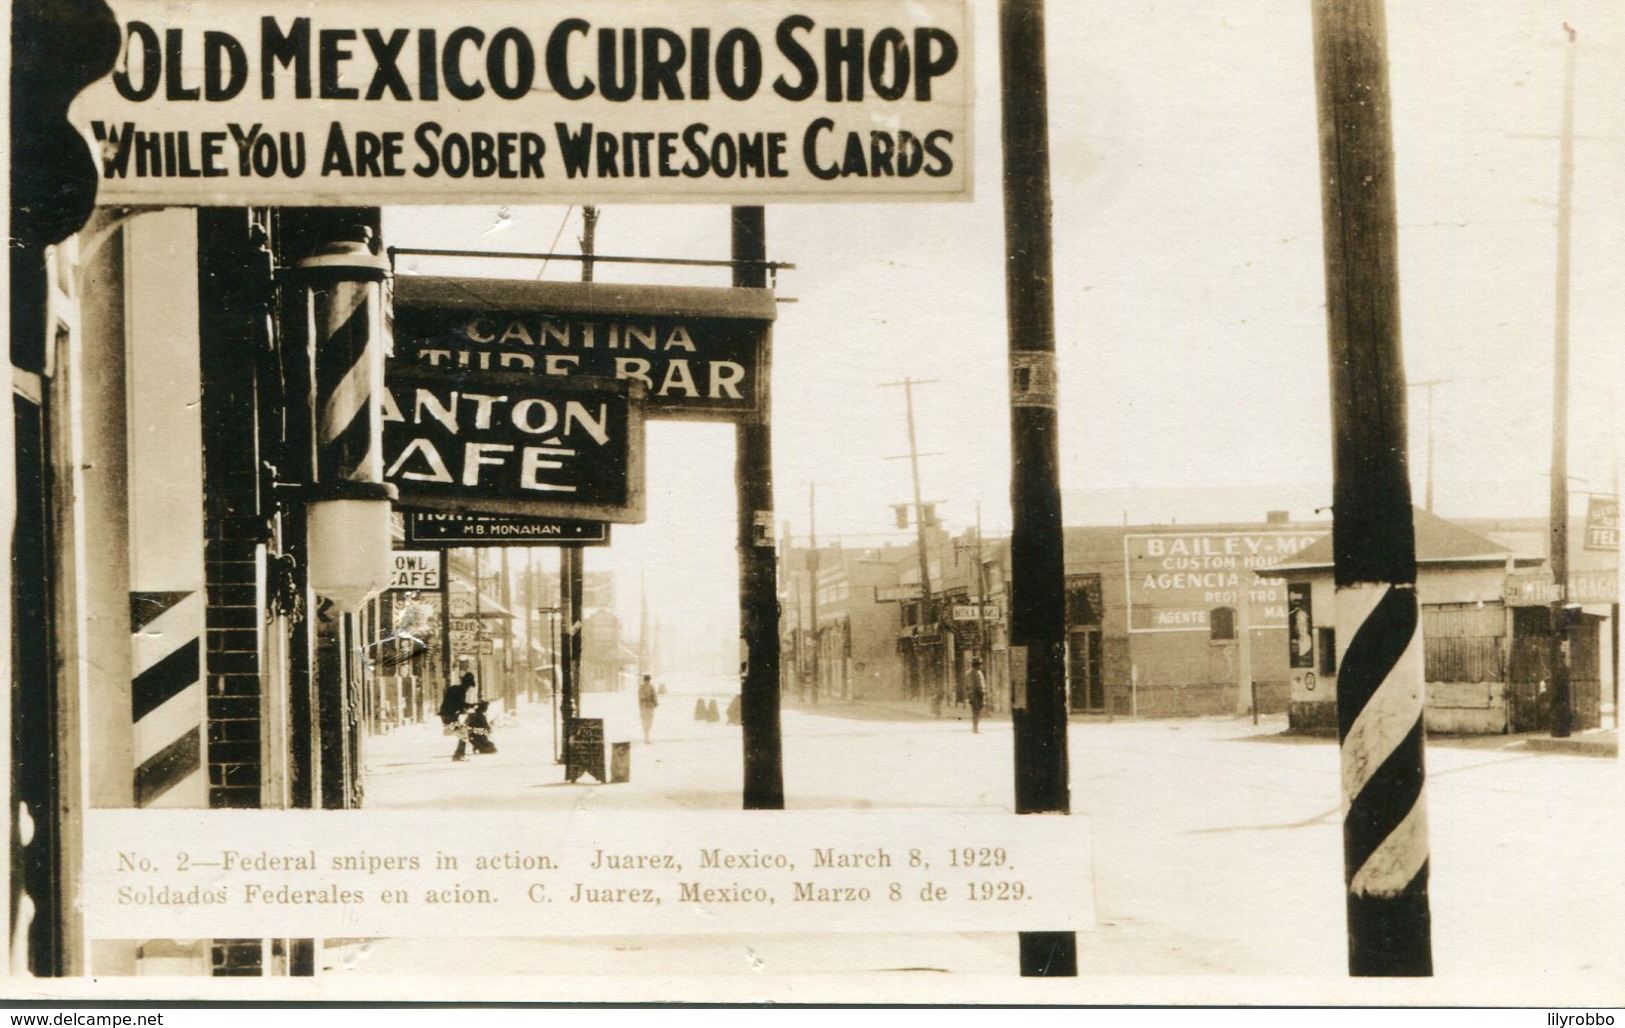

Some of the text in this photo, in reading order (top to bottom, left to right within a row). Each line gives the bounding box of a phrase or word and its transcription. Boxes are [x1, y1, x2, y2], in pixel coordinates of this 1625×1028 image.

[114, 14, 959, 103] OLD MEXICO CURIO SHOP
[91, 116, 955, 181] WHILE YOU ARE SOBER WRITE SOME CARDS
[467, 318, 698, 353] CANTINA
[615, 356, 746, 400] BAR
[490, 524, 562, 535] MONAHAN
[395, 556, 429, 571] OWL
[1162, 556, 1236, 570] CUSTOM
[1142, 573, 1240, 590] AGENCIA
[1157, 610, 1207, 625] AGENTE
